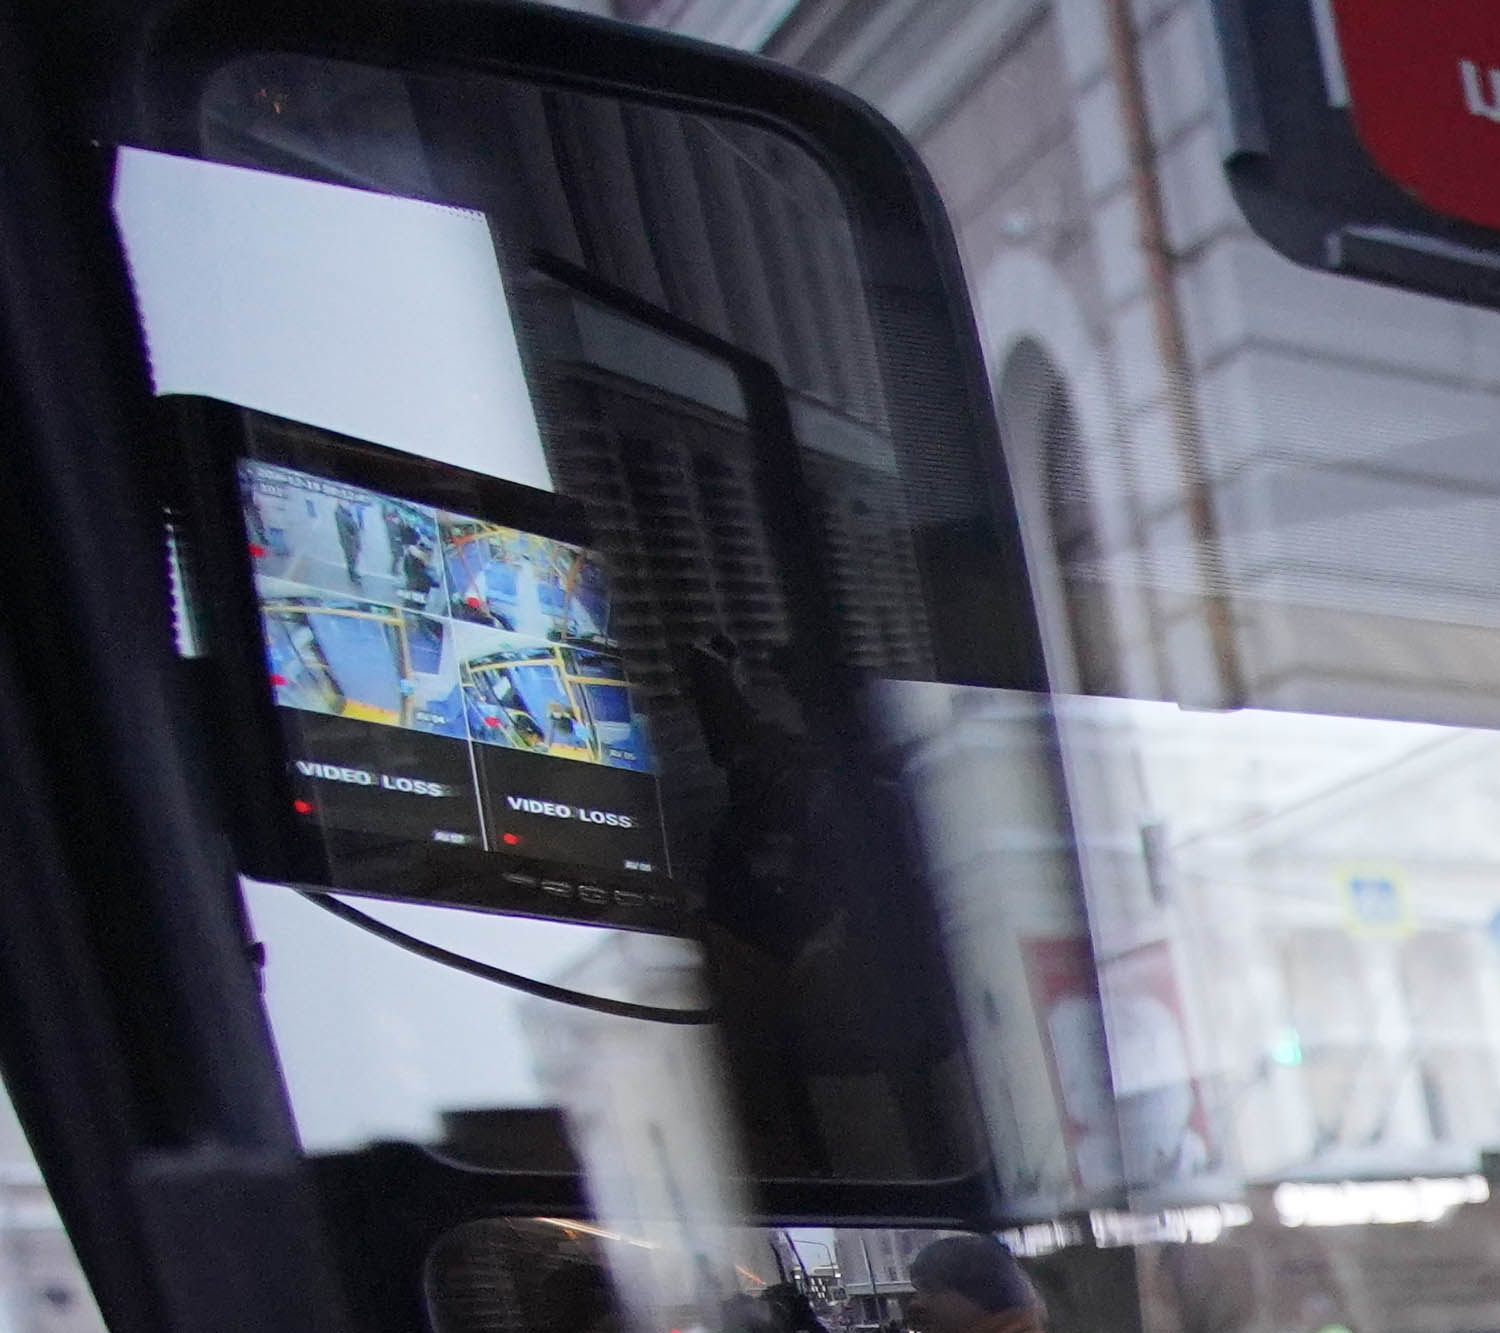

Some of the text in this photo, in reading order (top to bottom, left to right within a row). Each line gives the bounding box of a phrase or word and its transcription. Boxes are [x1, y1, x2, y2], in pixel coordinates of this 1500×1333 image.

[296, 760, 445, 798] VIDEO LOSS
[507, 795, 634, 829] VIDEO LOSS
